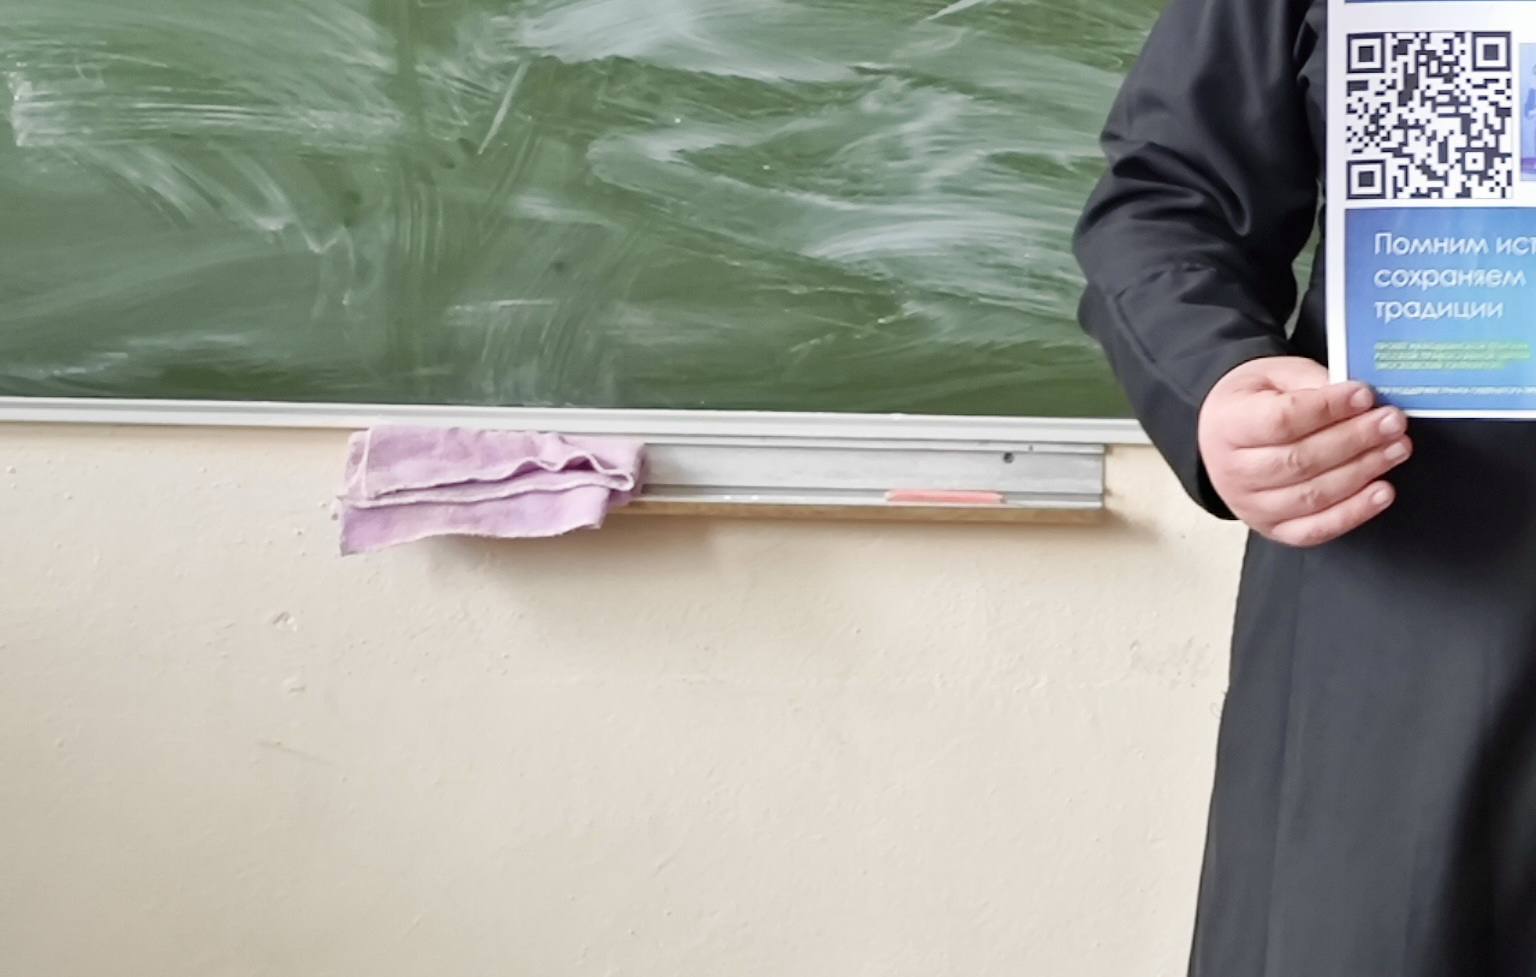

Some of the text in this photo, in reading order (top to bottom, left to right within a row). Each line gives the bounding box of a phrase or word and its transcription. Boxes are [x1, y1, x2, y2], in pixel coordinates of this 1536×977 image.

[1374, 232, 1489, 256] Помним
[1374, 268, 1527, 291] сохраняем
[1374, 300, 1504, 324] традиции
